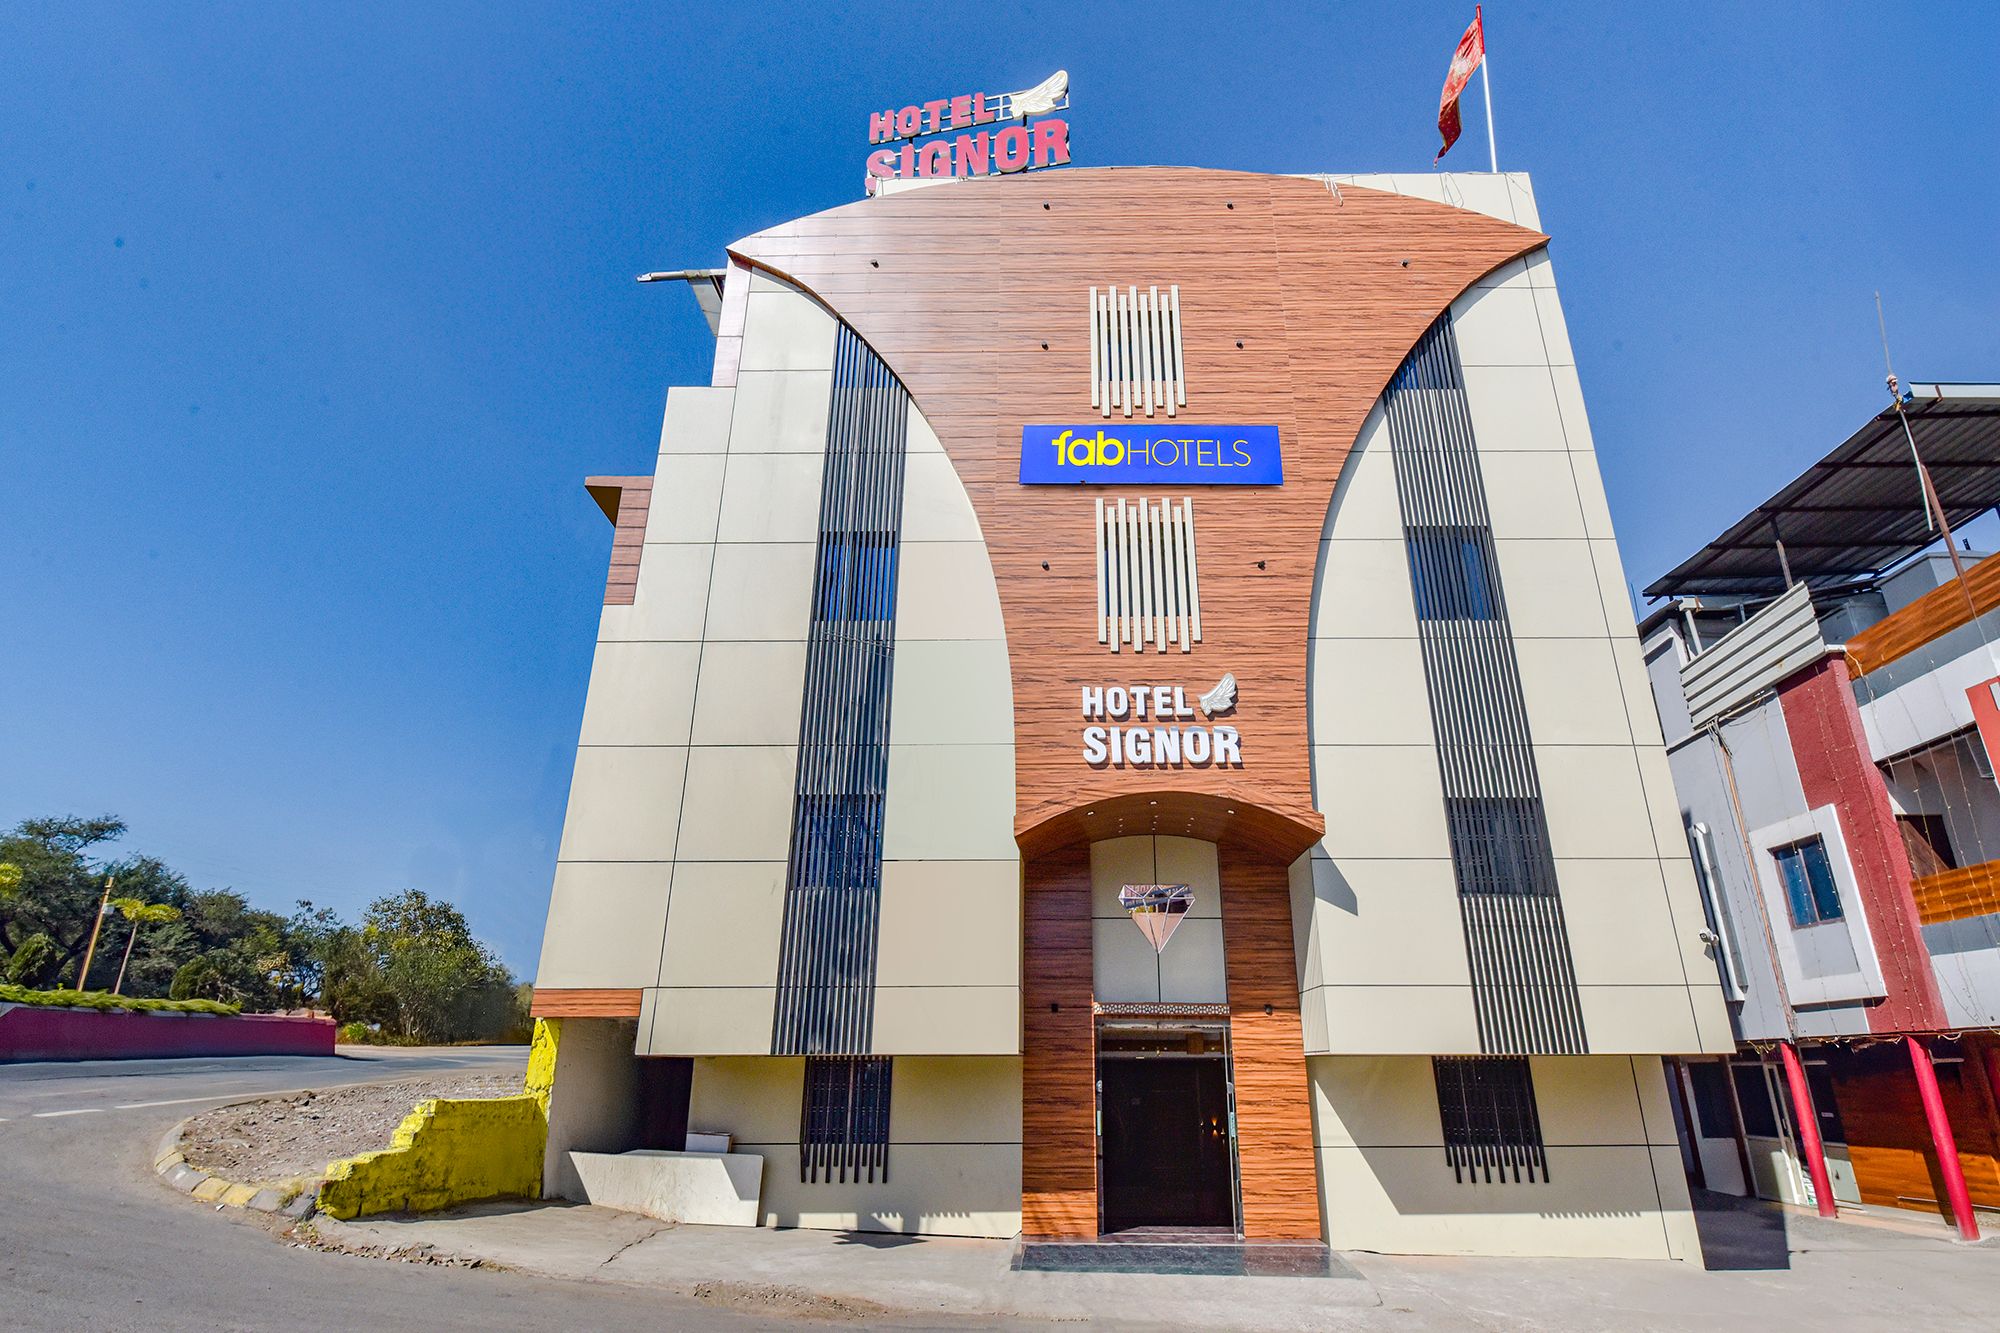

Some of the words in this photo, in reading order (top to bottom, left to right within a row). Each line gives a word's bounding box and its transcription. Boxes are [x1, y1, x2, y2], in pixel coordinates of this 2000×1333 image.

[869, 92, 995, 144] HOTEL
[865, 119, 1071, 194] SIGNOR
[1051, 430, 1252, 467] fabHOTELS
[1082, 686, 1194, 717] HOTEL
[1082, 726, 1243, 765] SIGNOR
